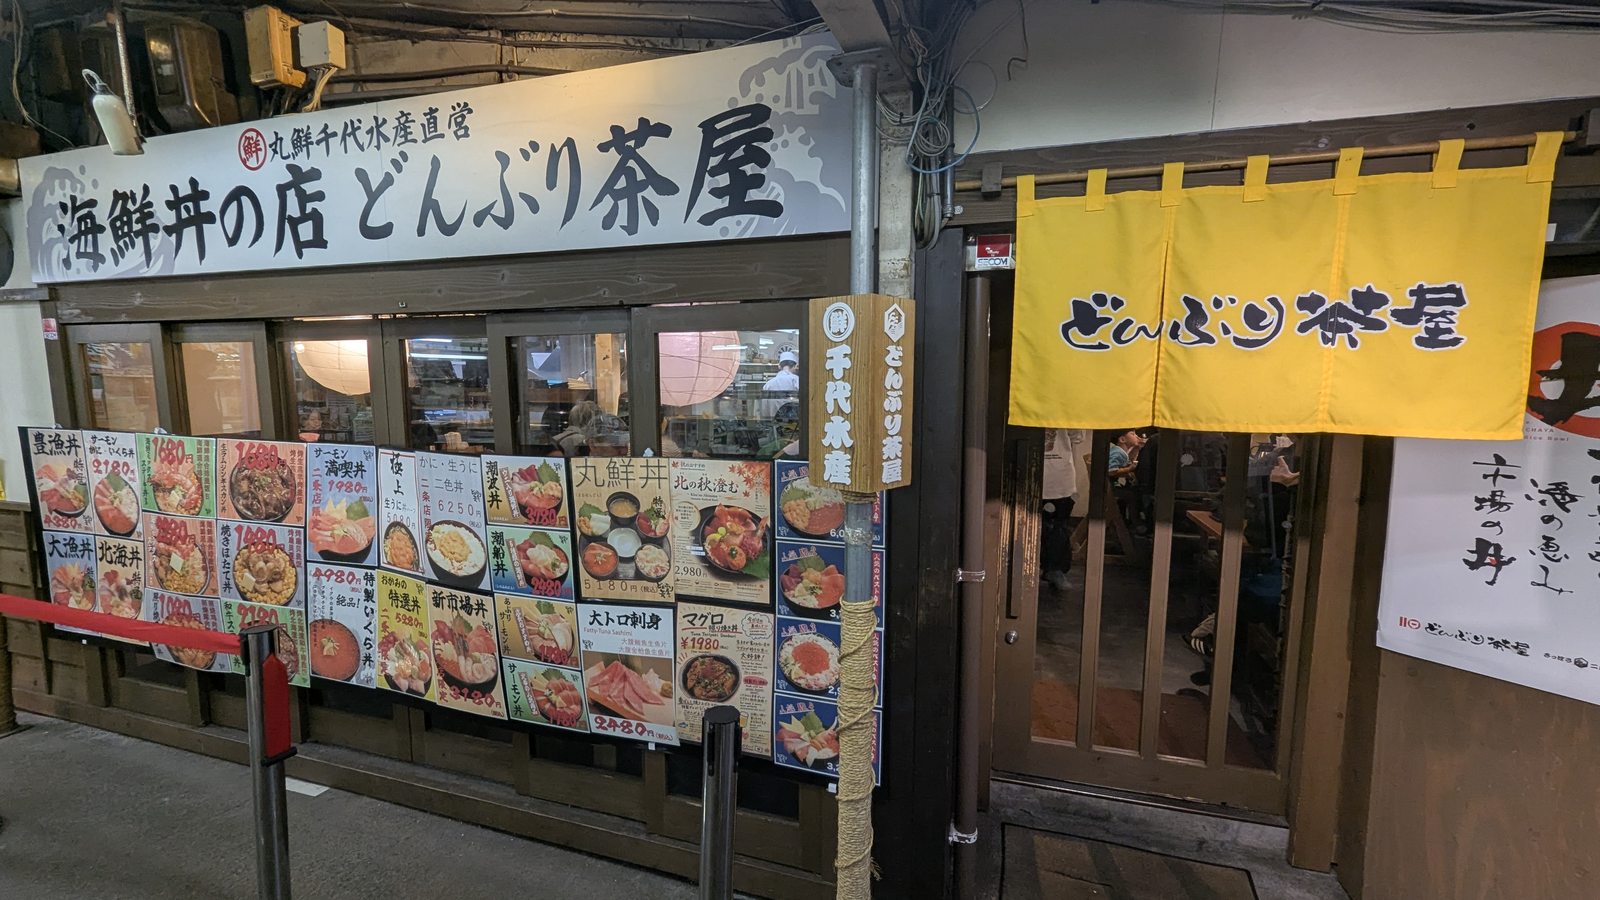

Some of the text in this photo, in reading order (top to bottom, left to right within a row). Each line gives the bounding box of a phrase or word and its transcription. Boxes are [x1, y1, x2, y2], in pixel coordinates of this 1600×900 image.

[240, 102, 473, 167] 鮮 丸鮮千代水産直営
[58, 103, 783, 272] 海鮮丼の店 どんぶり茶屋
[1060, 282, 1467, 351] どんぶり茶屋
[822, 344, 853, 485] 千代水産
[882, 345, 903, 484] どんぶり茶屋
[33, 431, 81, 457] 豊漁丼
[91, 435, 117, 446] サーモン
[314, 447, 348, 460] サーモン
[325, 459, 366, 480] 満喫丼
[390, 451, 404, 496] 極上
[420, 456, 478, 474] かに・生うに
[575, 458, 668, 490] 丸鮮丼
[328, 479, 368, 493] 1980円
[435, 478, 463, 493] 二色丼
[485, 461, 502, 509] 潮波丼
[674, 475, 739, 494] 北の秋澄む
[438, 500, 482, 517] 6250円
[48, 534, 94, 561] 大漁丼
[98, 540, 143, 569] 北海丼
[221, 524, 233, 594] 焼きほたて丼
[313, 567, 362, 585] 4980円
[381, 575, 407, 589] おかみの
[675, 566, 708, 578] 2,980円
[584, 580, 638, 593] 5180円
[336, 594, 360, 608] 絶品!
[388, 589, 421, 615] 特選丼
[432, 589, 488, 618] 新市場丼
[362, 571, 375, 667] 特製いくら丼
[589, 610, 662, 630] 大トロ刺身
[683, 612, 723, 627] マグロ
[499, 612, 511, 655] サーモン丼
[681, 637, 720, 650] ¥1980
[1424, 622, 1530, 657] どんぶり茶屋
[508, 663, 524, 717] サーモン丼
[594, 715, 655, 738] 2480円
